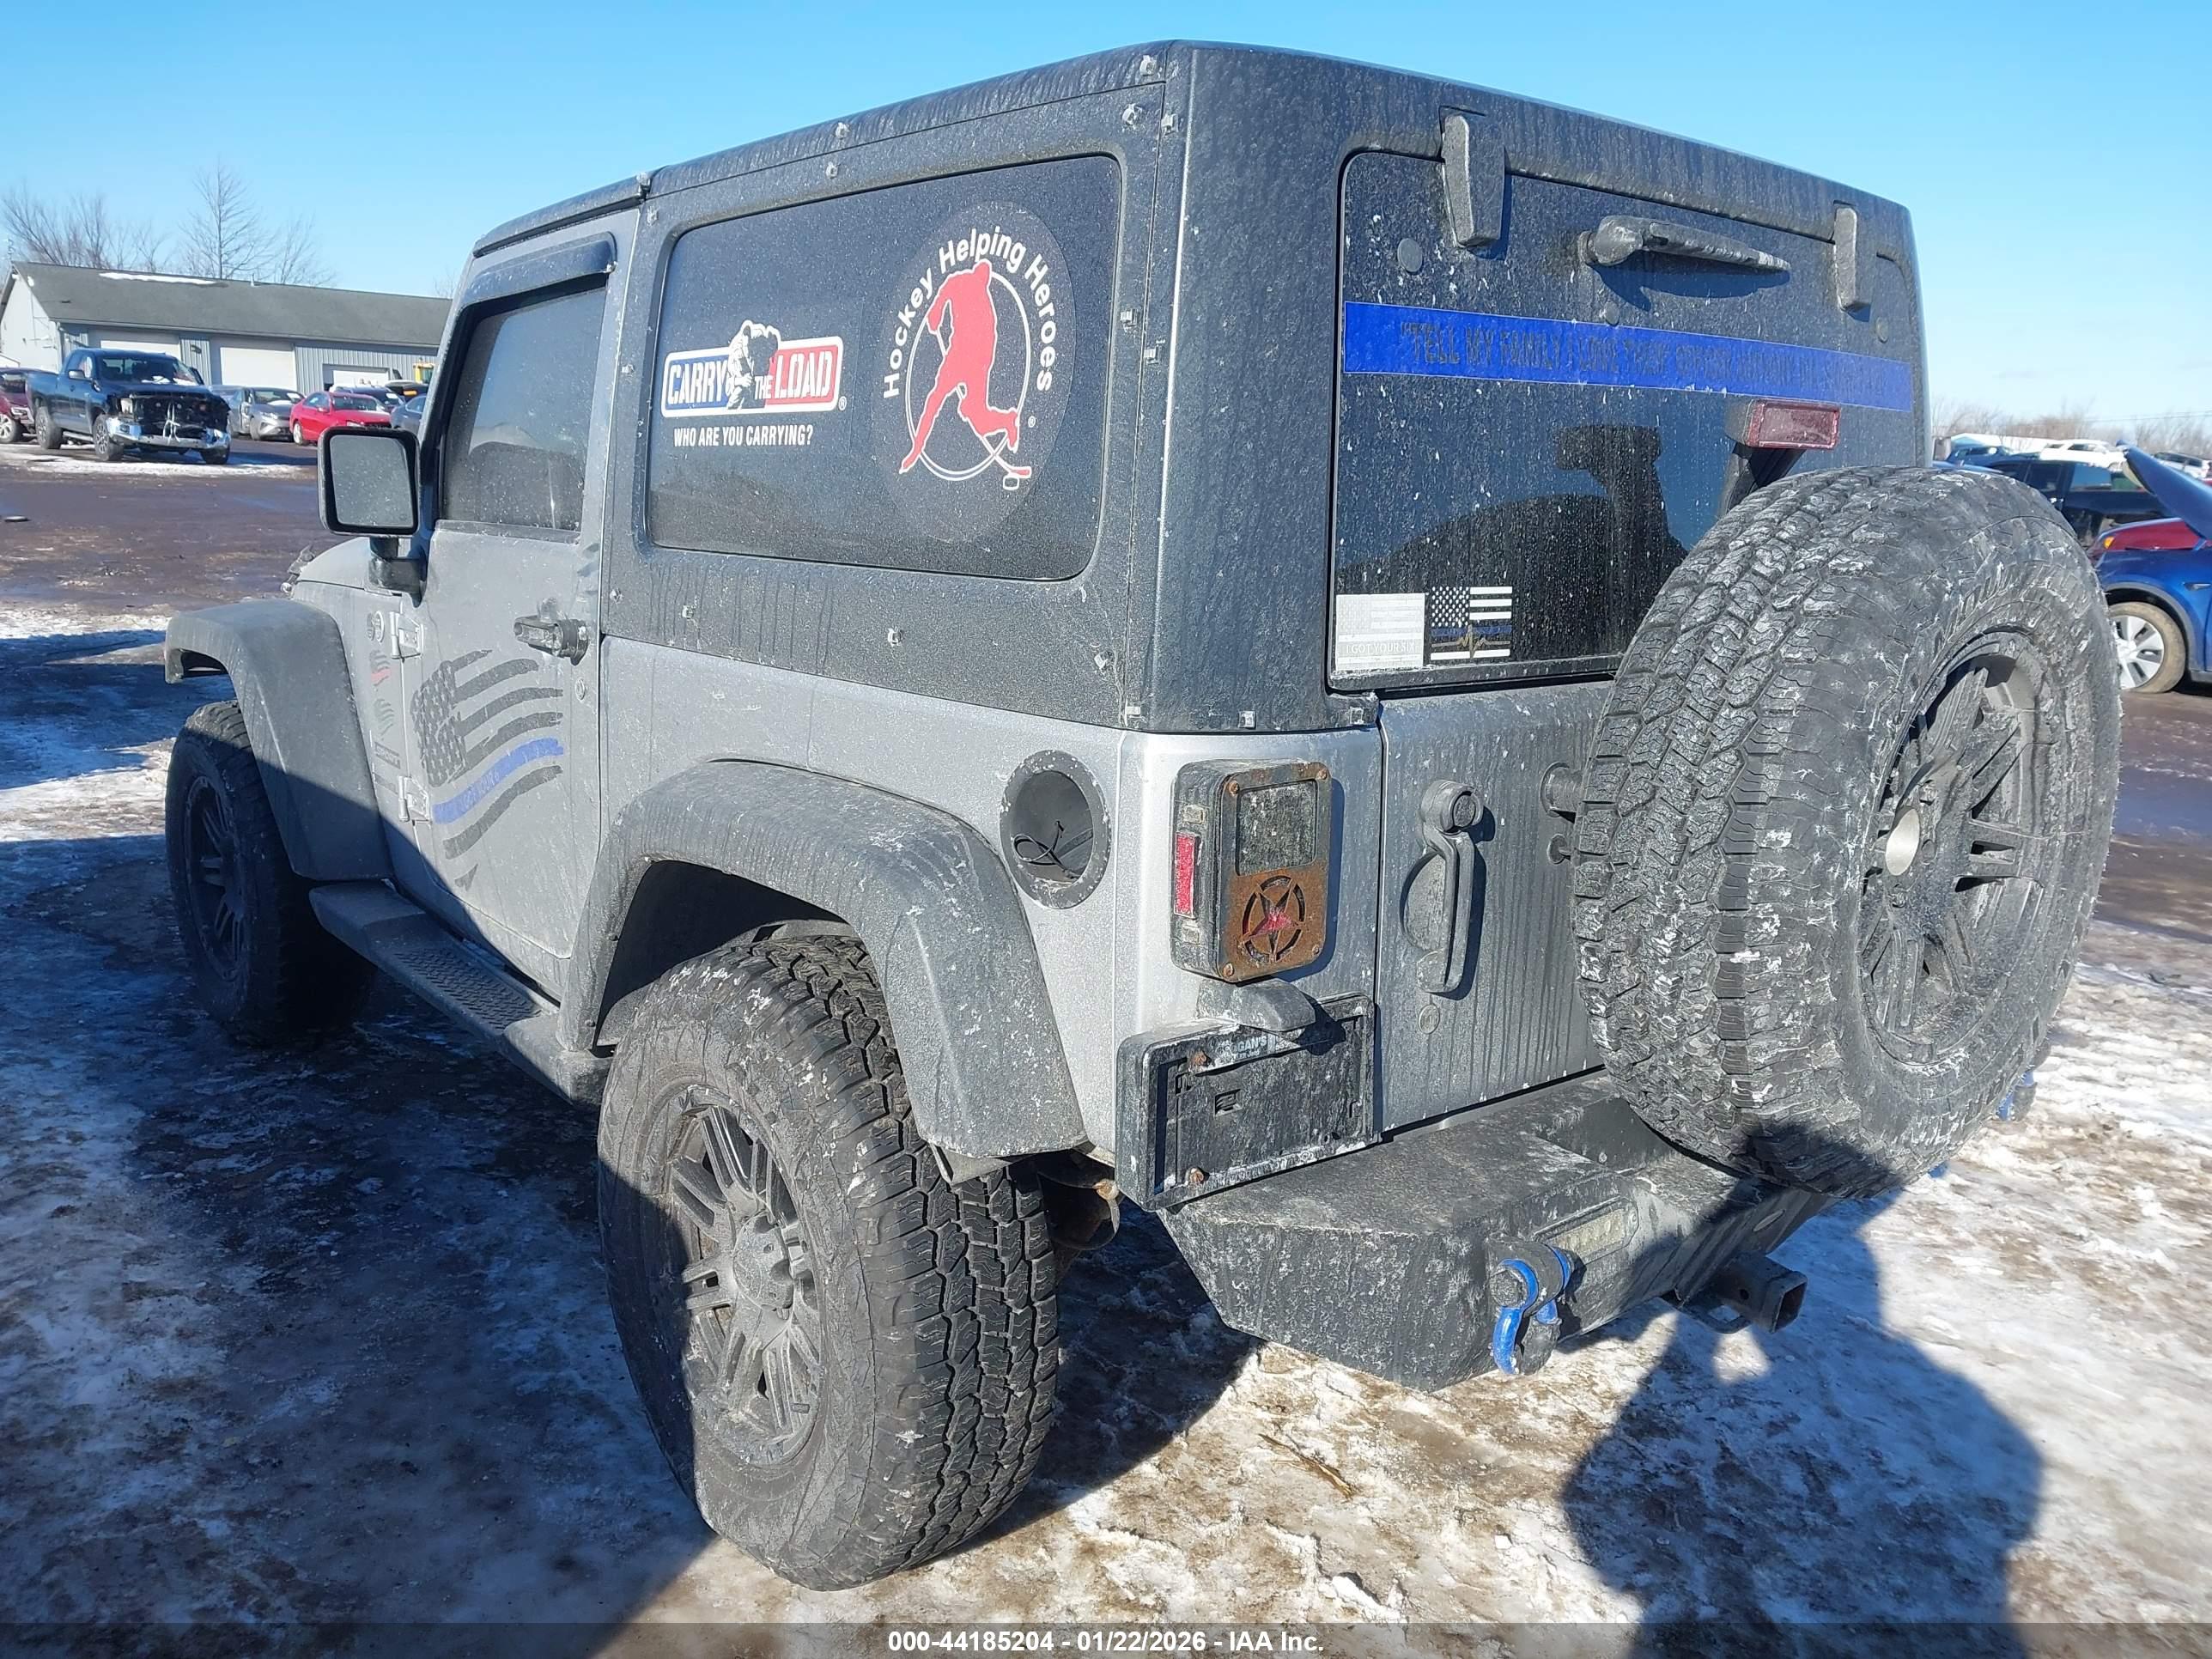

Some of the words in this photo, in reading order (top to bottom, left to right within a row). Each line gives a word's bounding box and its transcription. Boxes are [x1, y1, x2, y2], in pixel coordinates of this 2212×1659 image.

[883, 267, 933, 398] Hockey
[939, 226, 1027, 275] Helping
[1024, 254, 1056, 392] Heroes
[666, 361, 728, 405] CARRY
[754, 375, 774, 400] THE
[775, 350, 834, 400] LOAD
[673, 427, 697, 447] WHO
[698, 426, 720, 447] ARE
[722, 425, 744, 447] YOU
[745, 424, 814, 447] CARRYING?
[1351, 643, 1372, 654] GOT
[1373, 641, 1401, 654] YOUR
[1401, 641, 1415, 653] SIX
